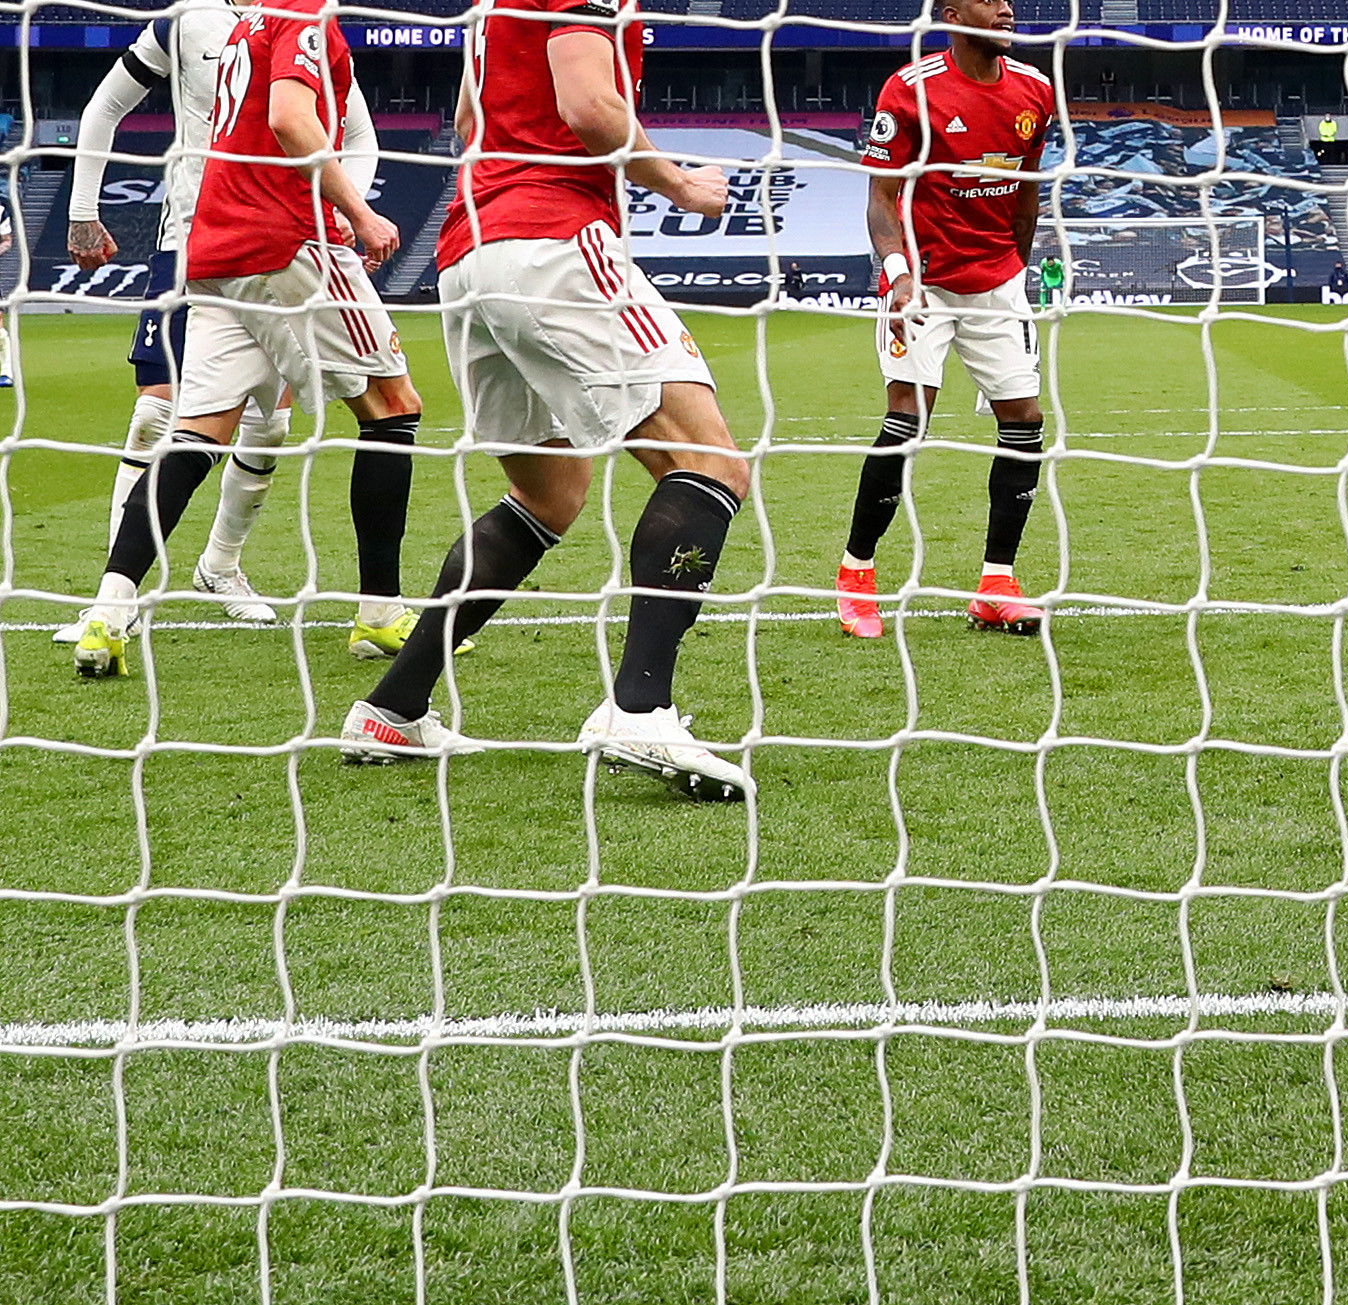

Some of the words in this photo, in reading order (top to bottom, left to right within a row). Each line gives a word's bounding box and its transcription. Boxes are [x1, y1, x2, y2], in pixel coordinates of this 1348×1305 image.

[366, 27, 423, 45] HOME
[429, 26, 455, 45] OF
[1238, 26, 1293, 43] HOME
[1299, 26, 1325, 43] OF
[950, 181, 1020, 199] CHEVROLET
